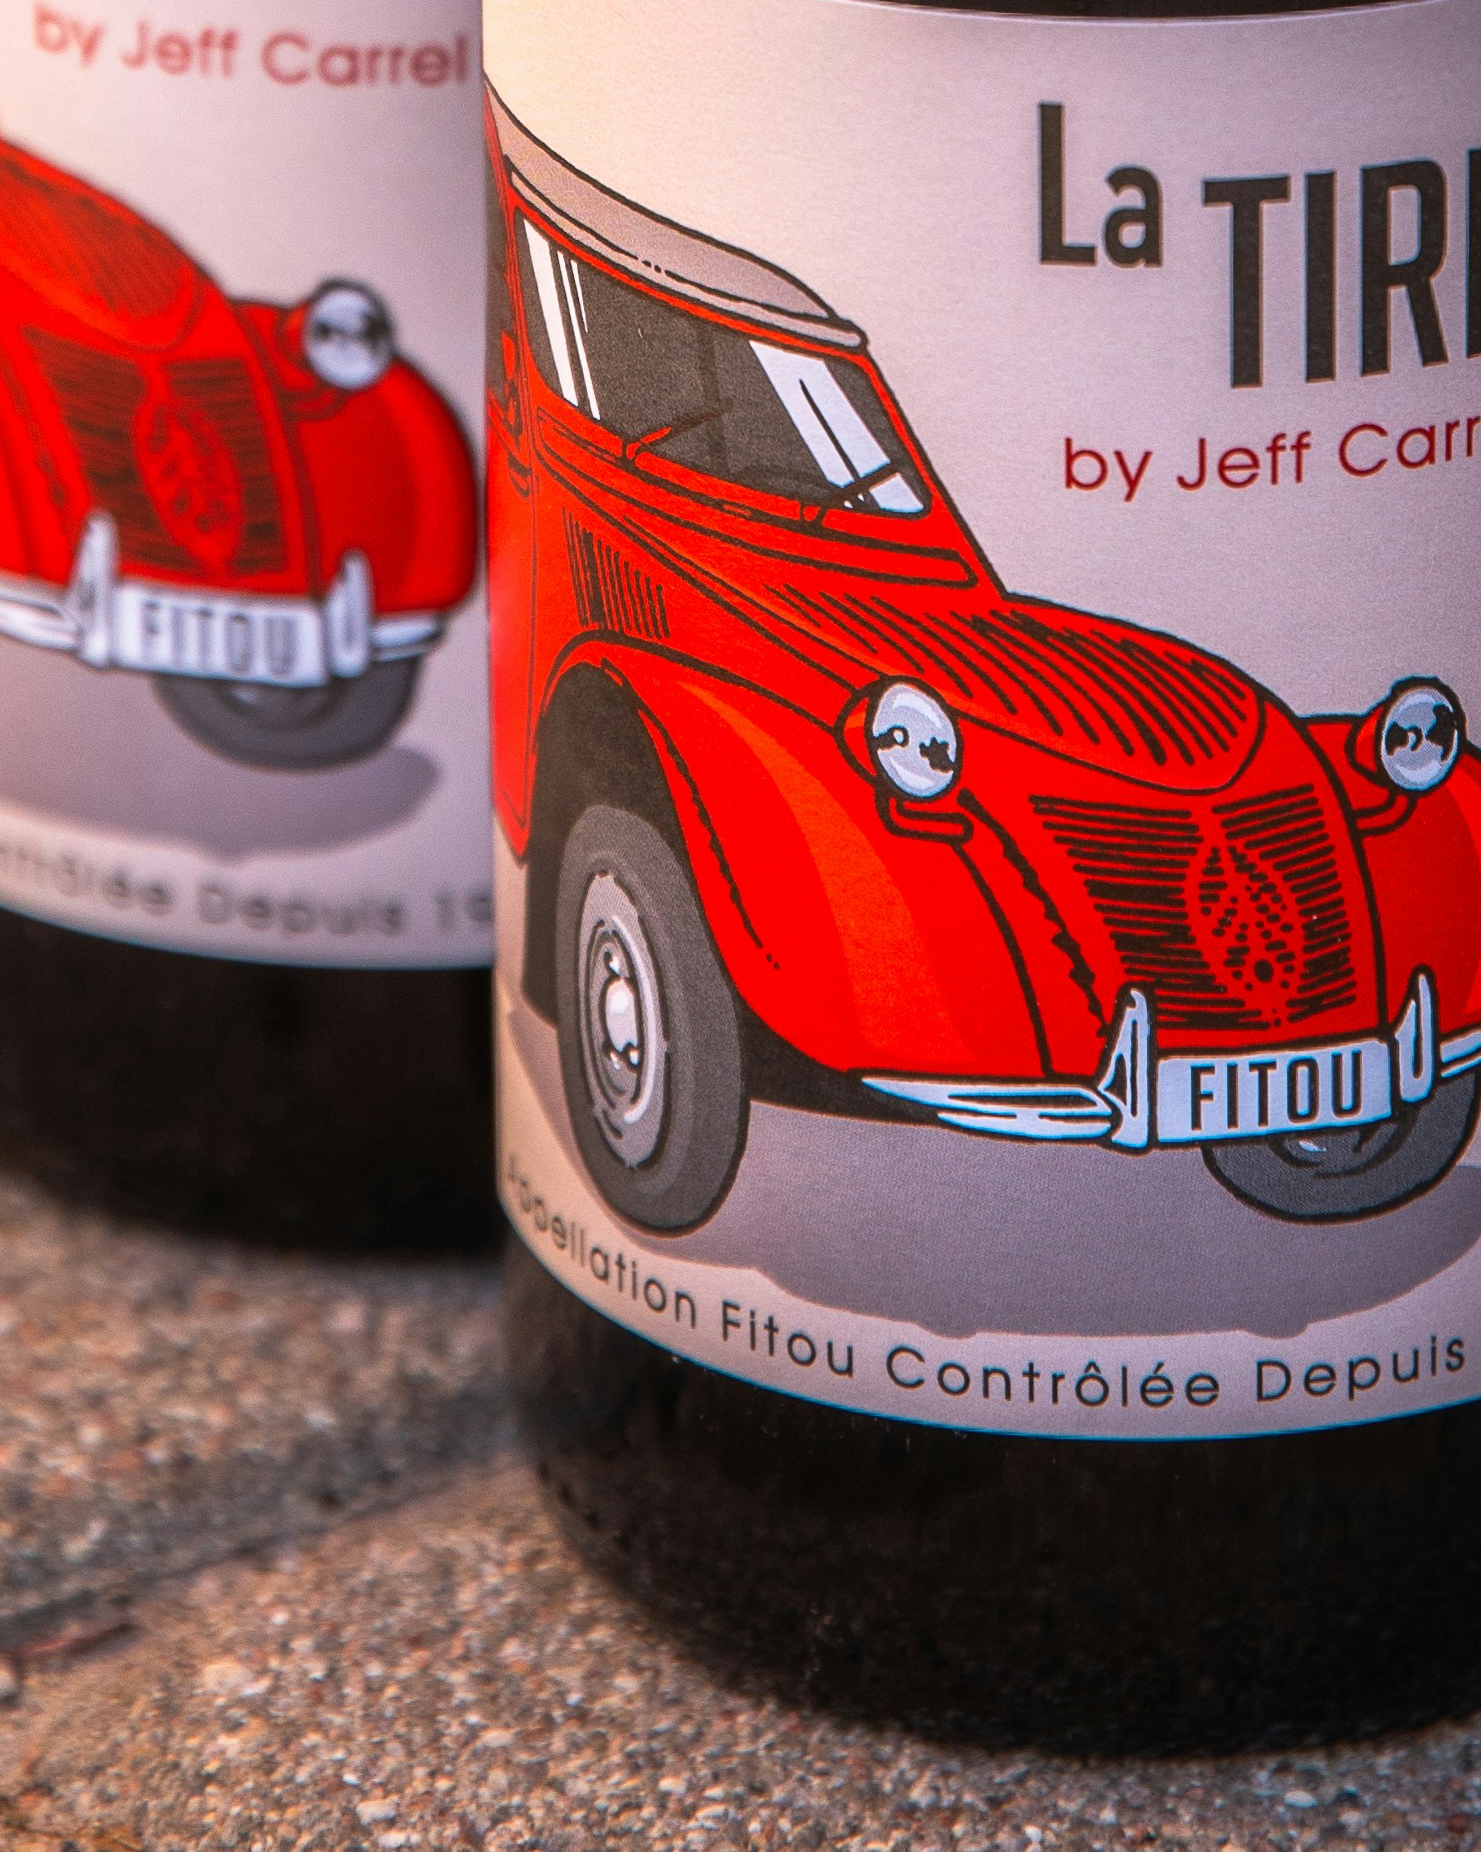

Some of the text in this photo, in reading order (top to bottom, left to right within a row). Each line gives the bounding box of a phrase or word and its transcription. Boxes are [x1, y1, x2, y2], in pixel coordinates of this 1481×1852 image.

[33, 2, 470, 88] by Jeff Carrel
[1038, 100, 1164, 270] La
[1063, 436, 1152, 503] by
[1175, 429, 1311, 492] Jeff
[142, 597, 301, 676] FITOU
[1189, 1048, 1364, 1132] FITOU
[720, 1298, 855, 1379] Fitou
[885, 1343, 1221, 1408] Contrôlée
[1255, 1333, 1466, 1403] Depuis
